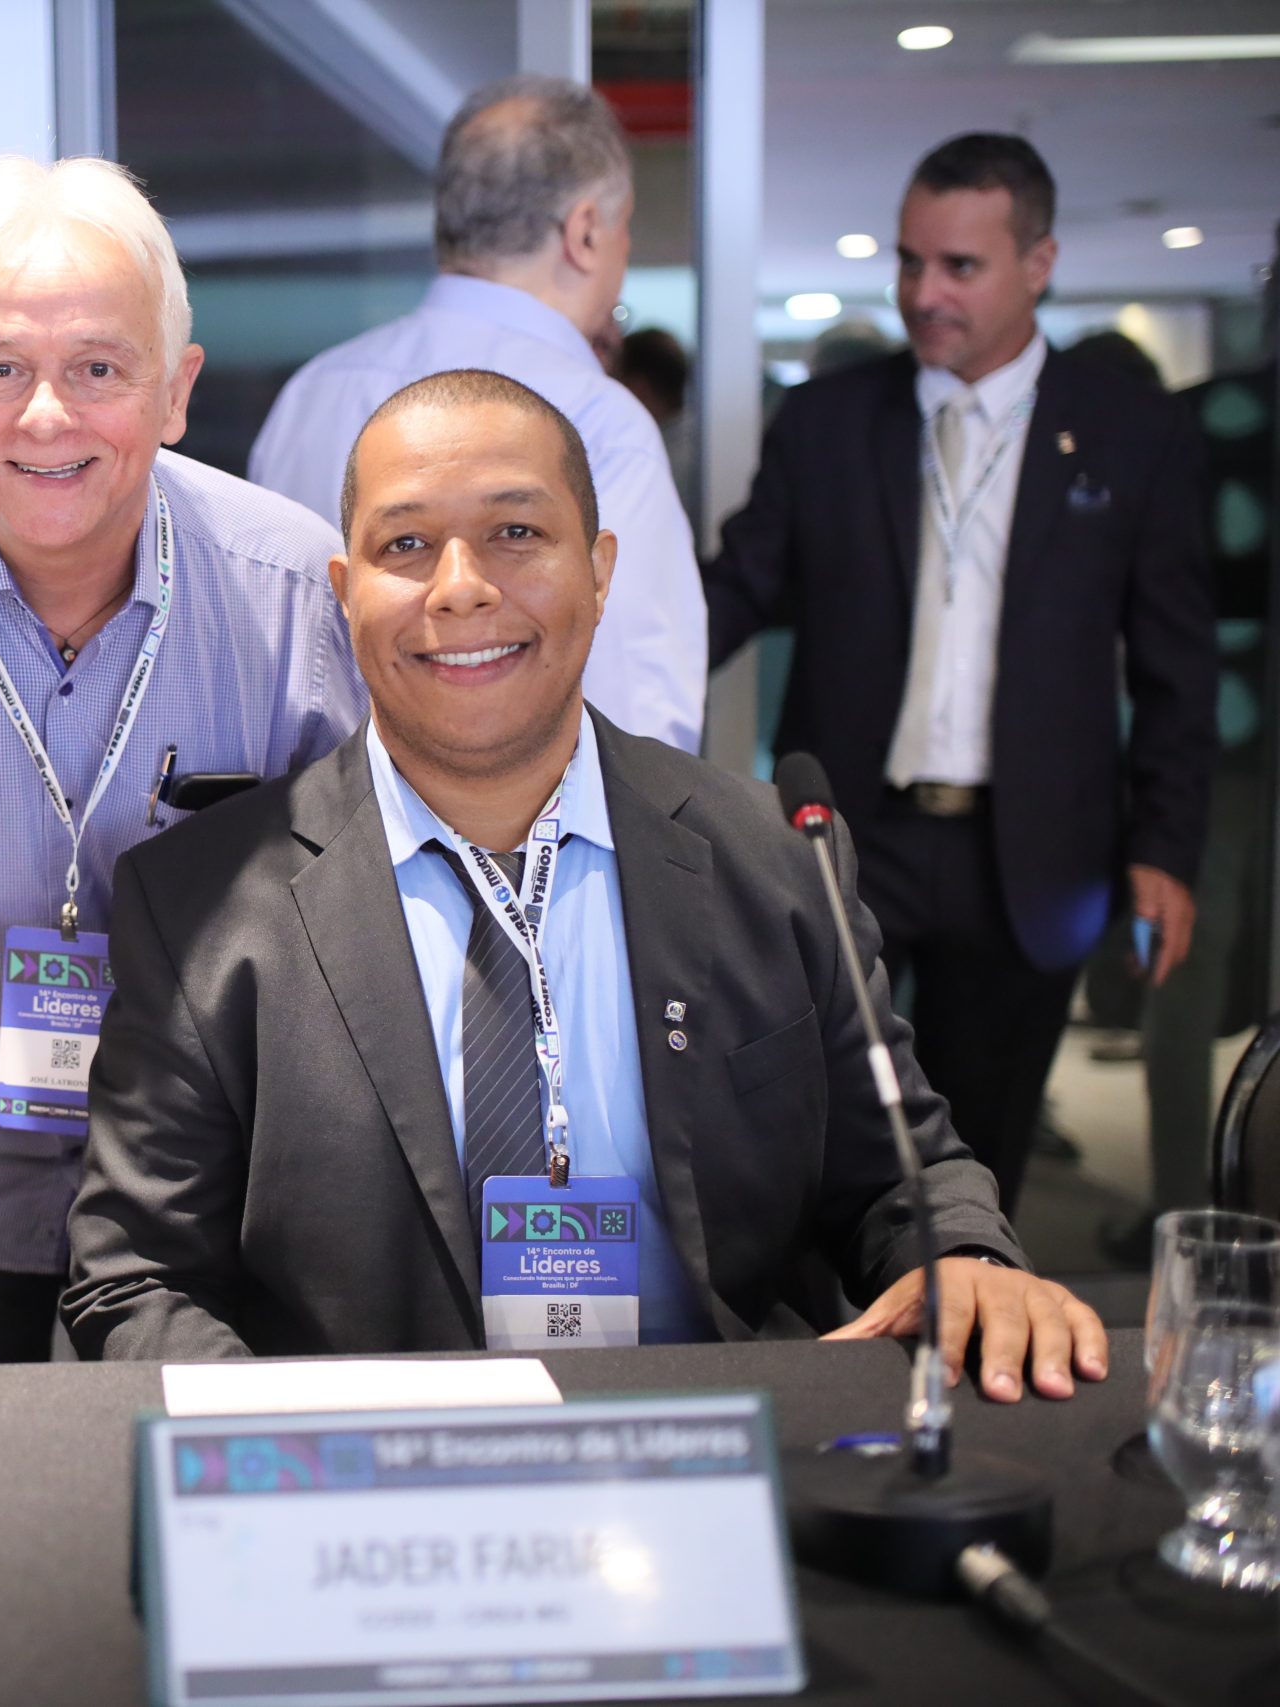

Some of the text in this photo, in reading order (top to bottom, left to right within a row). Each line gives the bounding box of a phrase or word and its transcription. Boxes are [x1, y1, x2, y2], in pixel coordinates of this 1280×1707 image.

[108, 658, 149, 757] CONFEA CREA
[531, 845, 552, 904] CONFEA
[504, 902, 530, 938] CREA
[32, 995, 102, 1018] Líderes
[539, 967, 552, 1027] CONFEA
[520, 1255, 601, 1274] Líderes
[543, 1247, 582, 1256] Encontro
[584, 1247, 596, 1256] de
[312, 1536, 460, 1590] JADER
